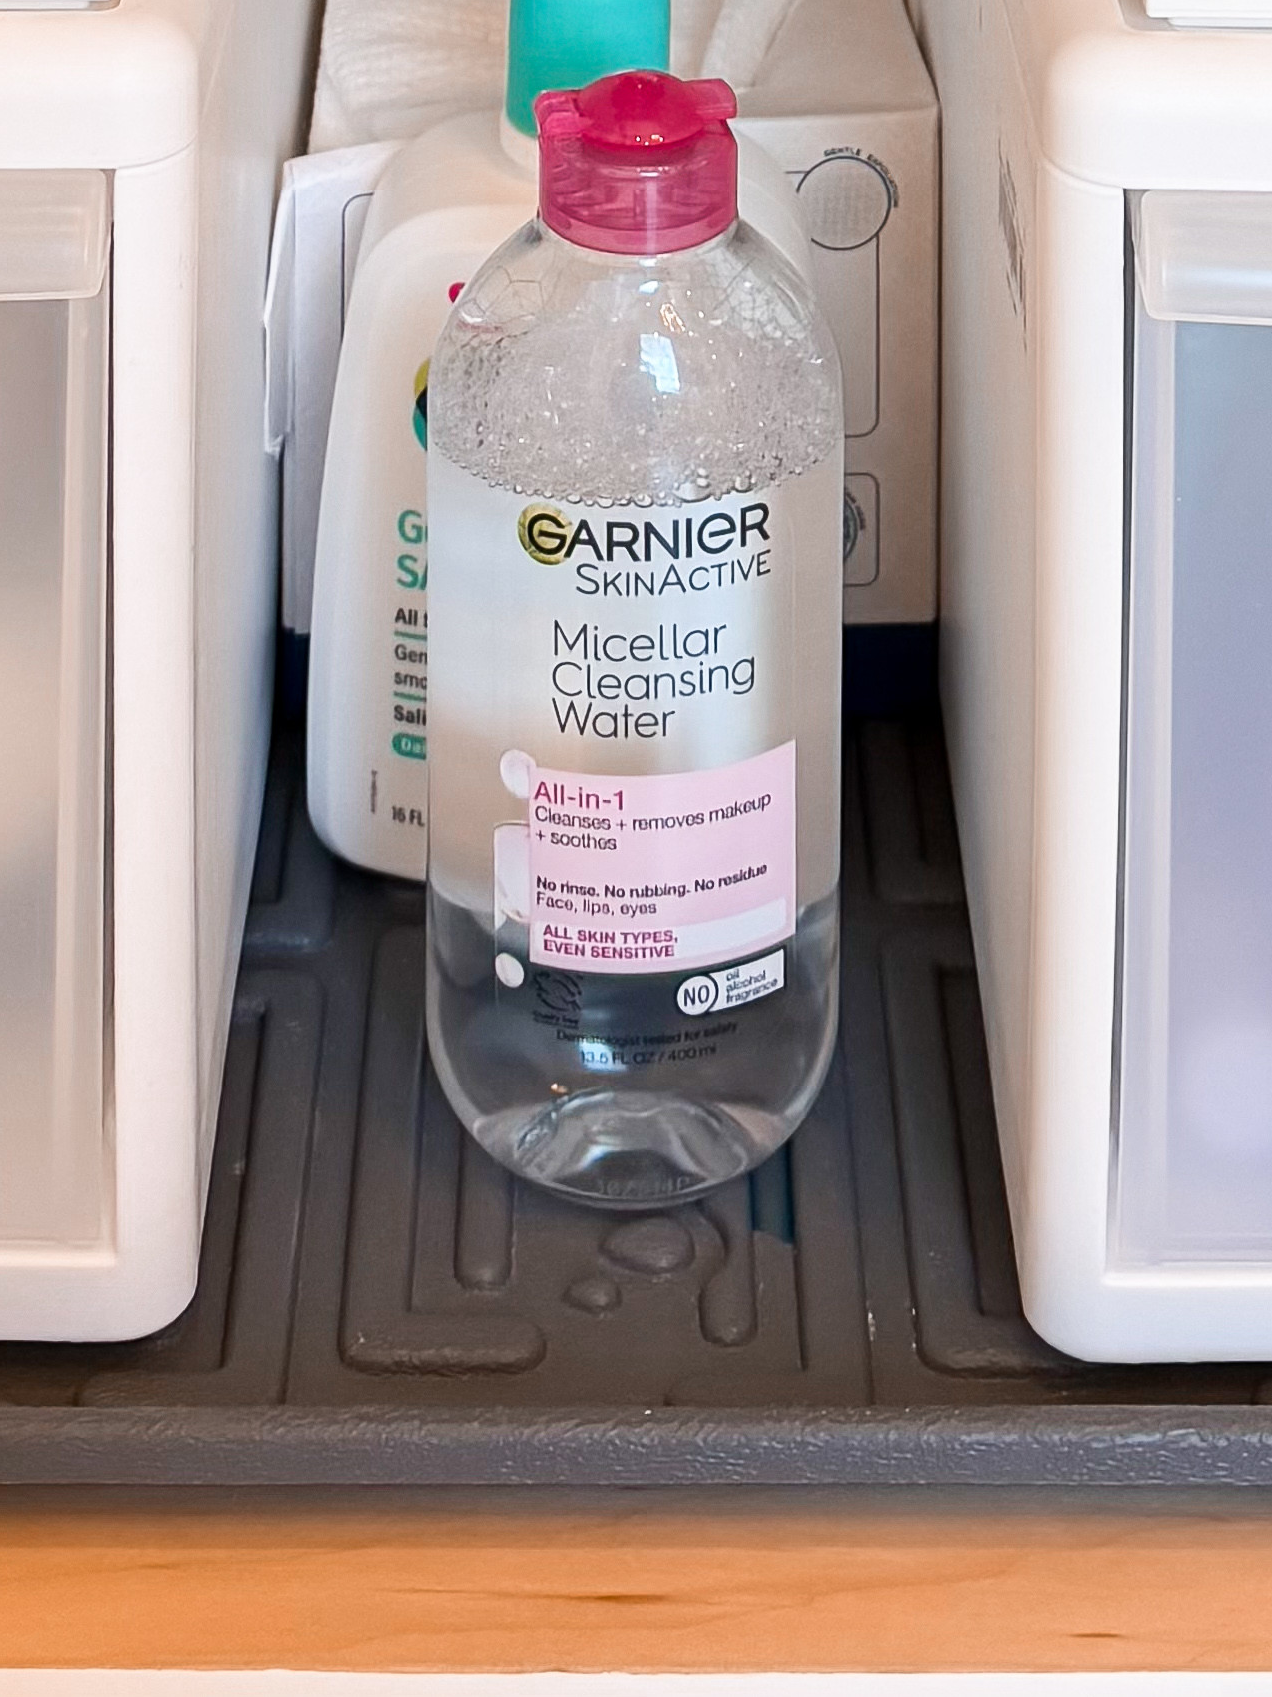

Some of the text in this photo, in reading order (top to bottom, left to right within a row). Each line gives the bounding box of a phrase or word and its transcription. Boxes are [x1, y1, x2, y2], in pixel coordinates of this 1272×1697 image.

[397, 509, 428, 544] G
[526, 501, 772, 563] GARNIER
[394, 607, 419, 628] All
[553, 619, 728, 663] Micellar
[552, 656, 755, 702] Cleansing
[552, 697, 676, 740] Water
[534, 780, 625, 812] All-in-1
[409, 808, 426, 828] FL
[534, 792, 772, 832] Cleanses + removes makeup
[550, 831, 618, 851] soothes
[536, 863, 768, 900] No rinse. No rubbing. No residue
[536, 891, 578, 915] Face,
[620, 901, 657, 919] eyes
[543, 923, 678, 946] ALL SKIN TYPES,
[543, 938, 675, 960] EVEN SENSITIVE
[726, 969, 767, 994] alcohol
[726, 979, 778, 1005] fragrance
[683, 985, 710, 1007] NO
